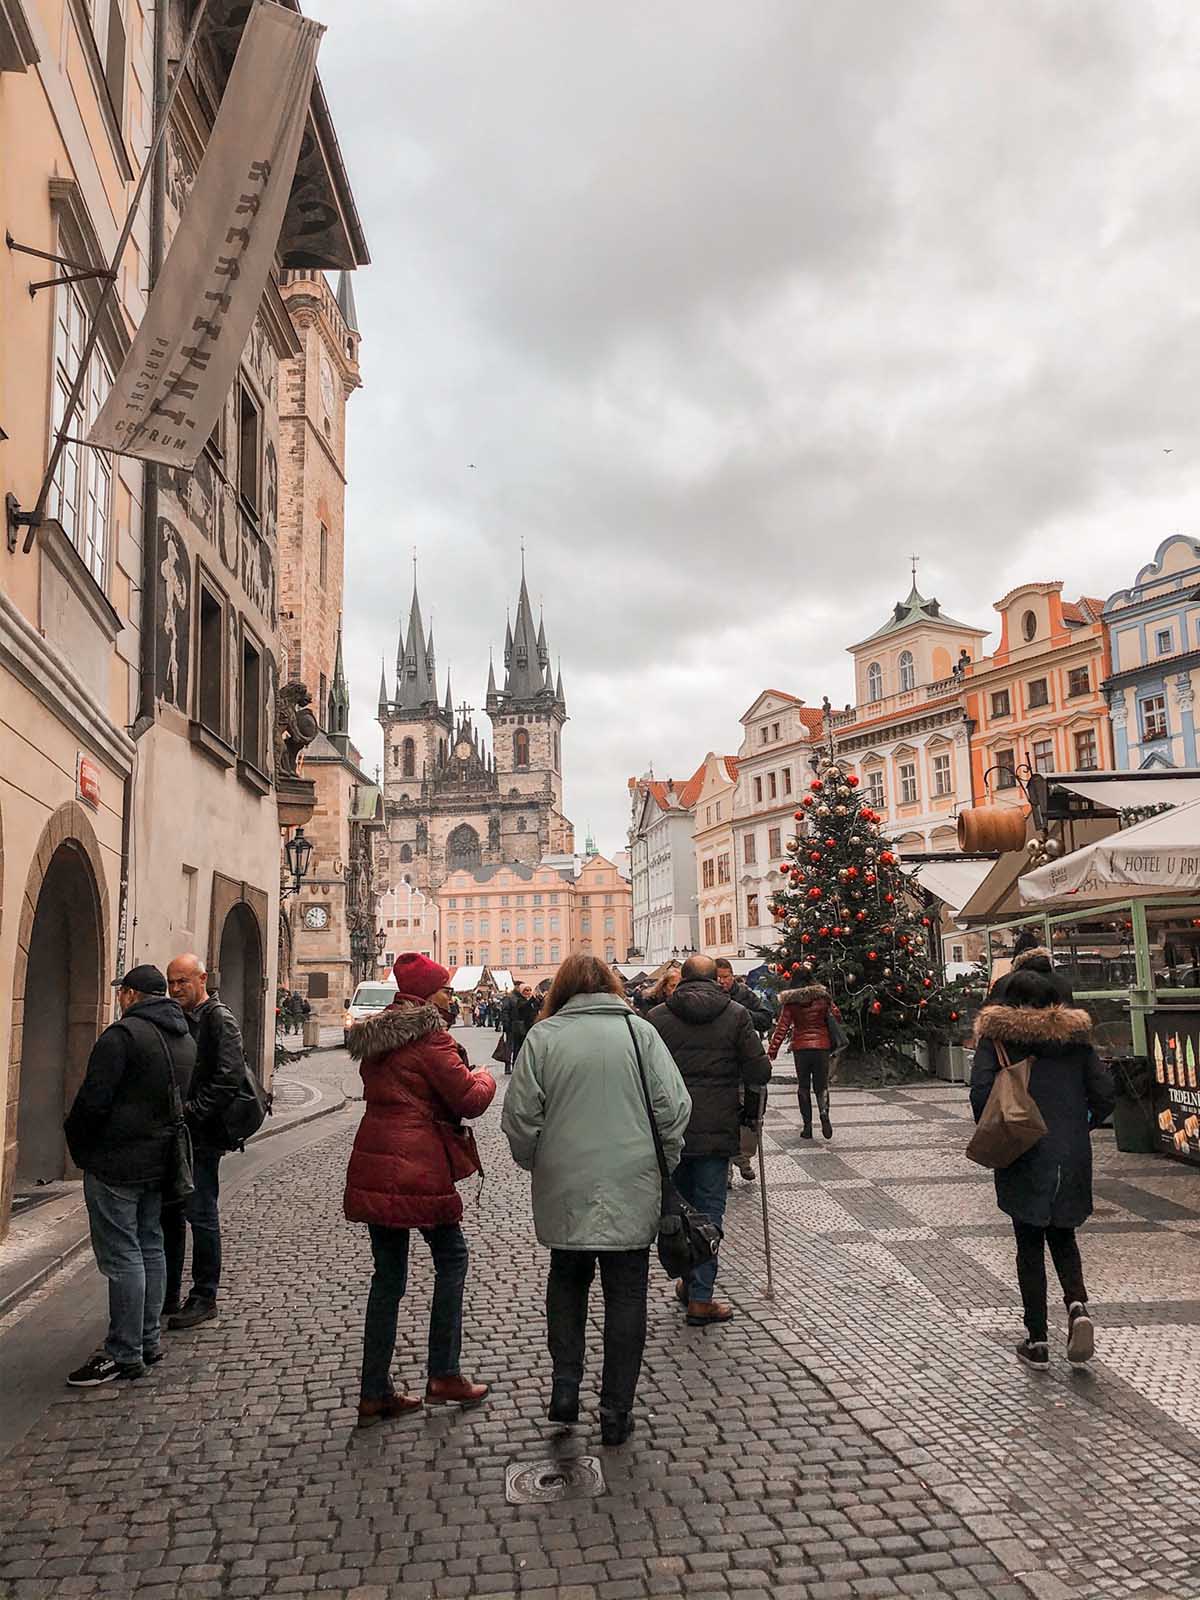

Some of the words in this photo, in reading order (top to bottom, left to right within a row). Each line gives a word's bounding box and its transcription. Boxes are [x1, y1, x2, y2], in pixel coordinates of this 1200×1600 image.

[114, 420, 187, 450] CETRUM
[1123, 856, 1160, 873] HOTEL
[1167, 857, 1176, 874] U
